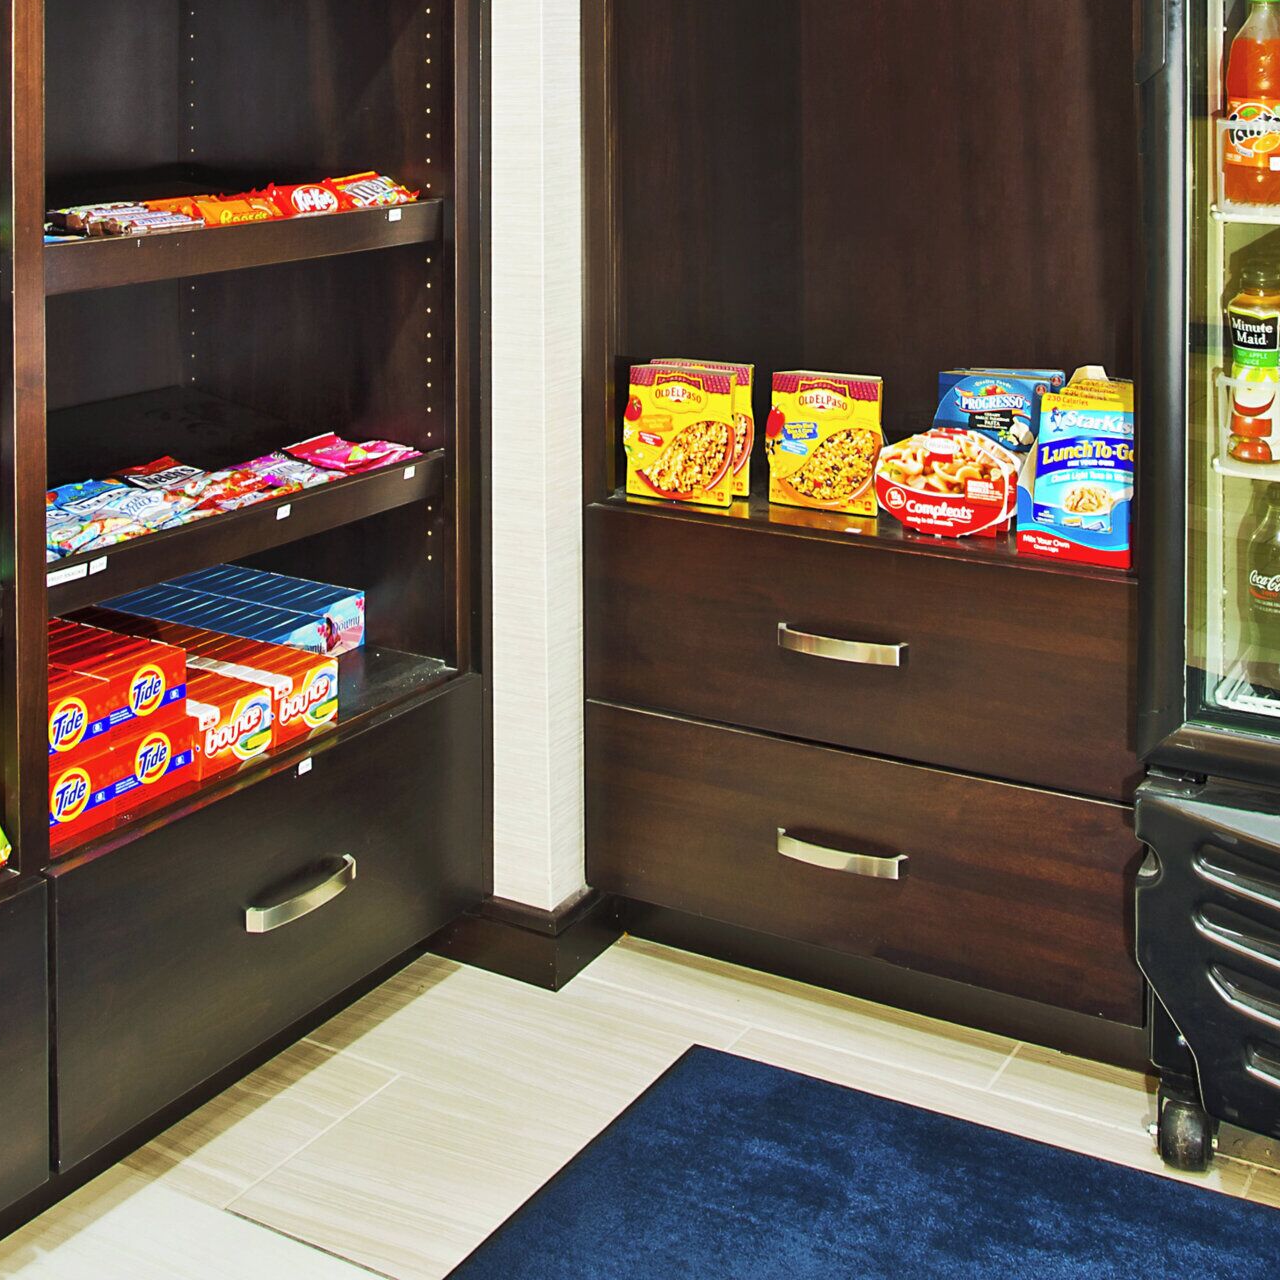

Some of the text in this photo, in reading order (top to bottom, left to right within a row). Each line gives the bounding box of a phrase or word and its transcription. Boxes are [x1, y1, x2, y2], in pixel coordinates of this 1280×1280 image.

[1231, 318, 1274, 335] Minute
[1236, 331, 1269, 346] Maid
[961, 394, 1023, 410] PROGRESSO
[1062, 395, 1089, 407] Calories
[1064, 410, 1134, 435] StarKis
[1041, 441, 1093, 466] Lunch
[905, 498, 974, 521] Compleats
[133, 678, 162, 710] Tide
[52, 709, 85, 745] Tide
[137, 745, 168, 779] Tide
[55, 782, 87, 817] Tide
